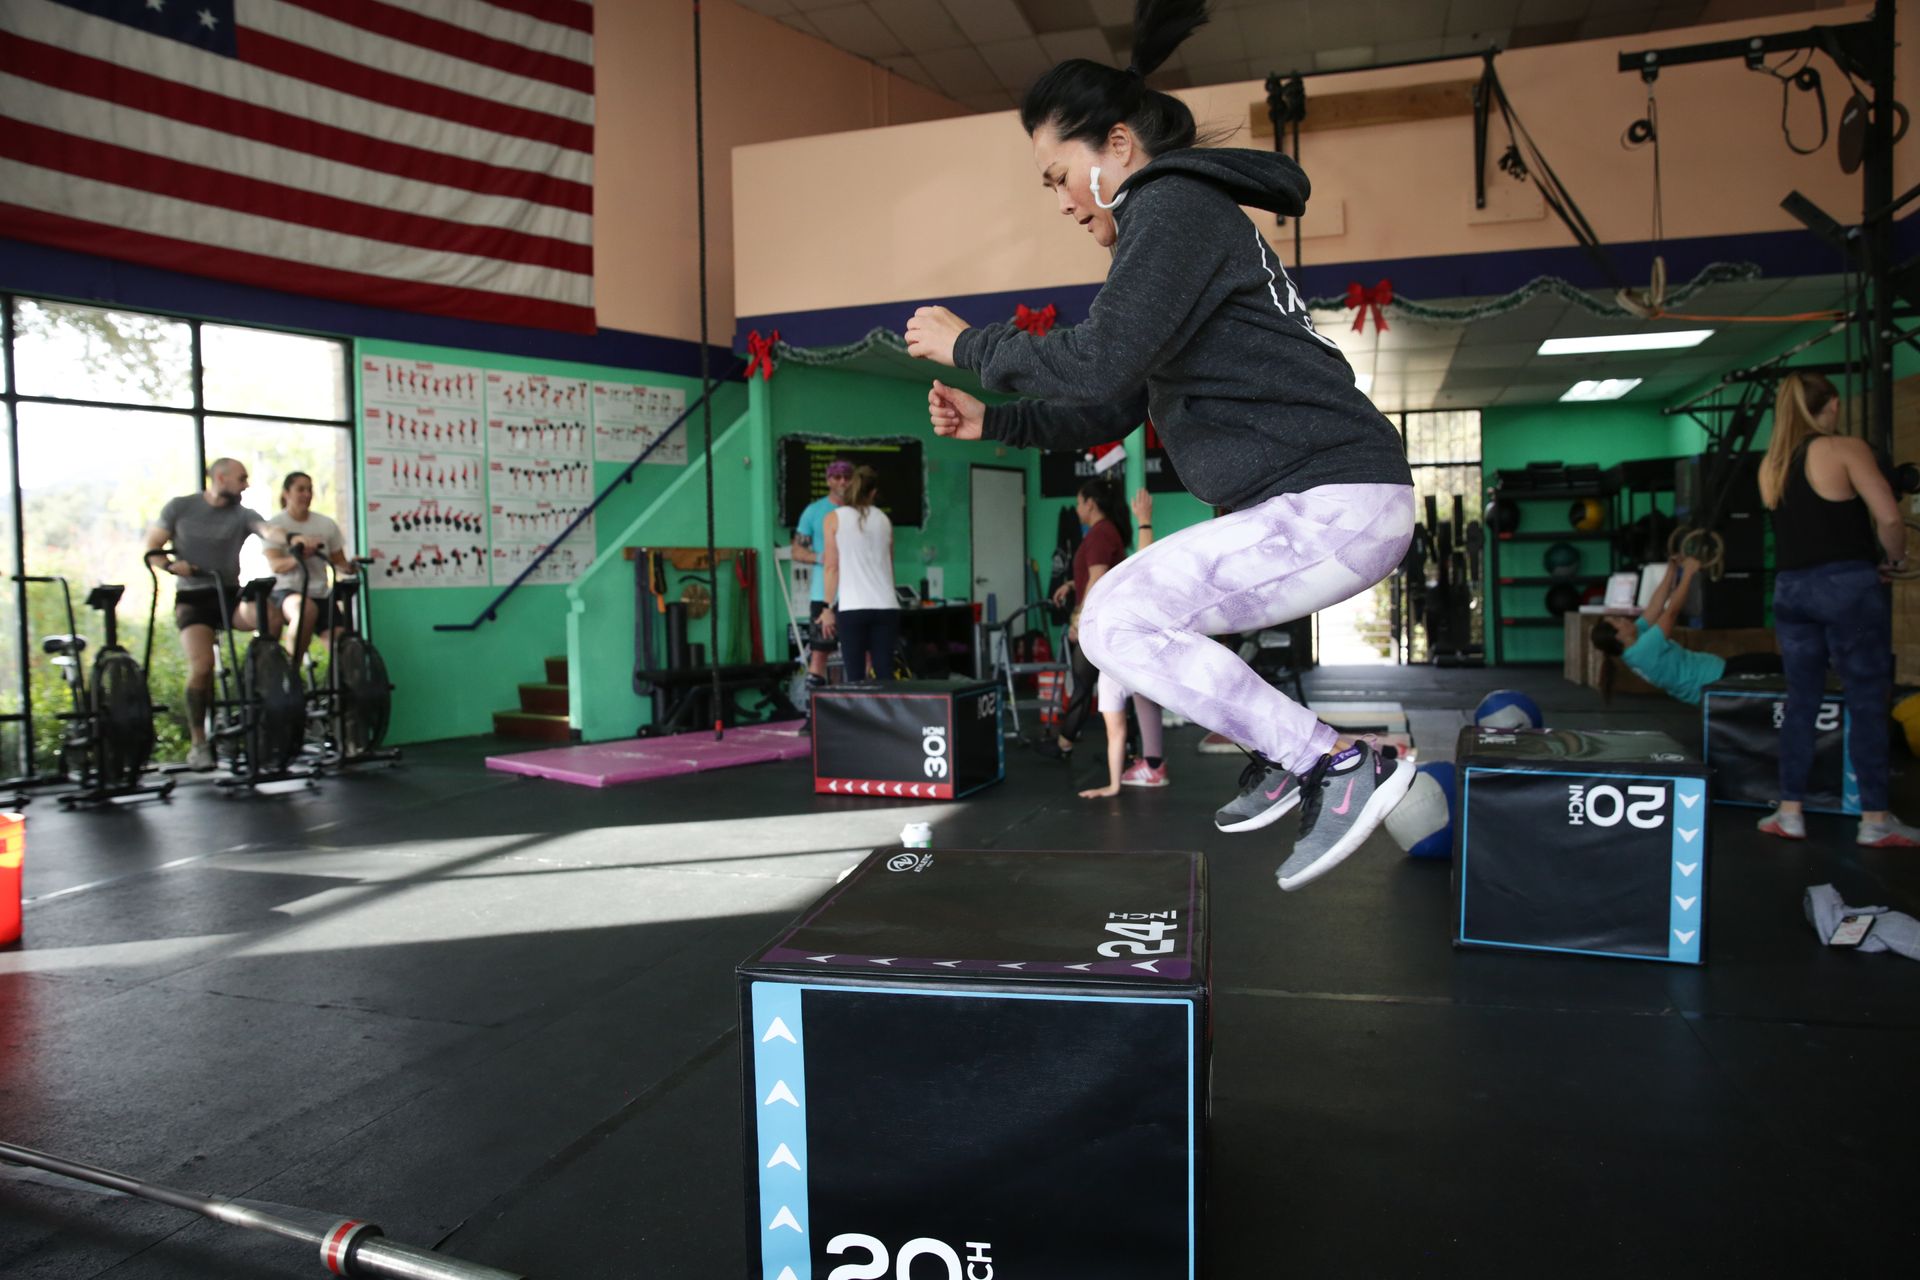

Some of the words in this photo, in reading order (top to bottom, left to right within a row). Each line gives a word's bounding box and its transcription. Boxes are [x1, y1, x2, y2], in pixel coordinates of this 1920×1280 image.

[922, 726, 946, 736] INCH
[1815, 703, 1840, 731] 2
[923, 735, 948, 778] 30
[1568, 784, 1584, 826] INCH
[1585, 784, 1667, 829] 20
[1108, 909, 1177, 920] INCH
[1097, 921, 1178, 958] 24
